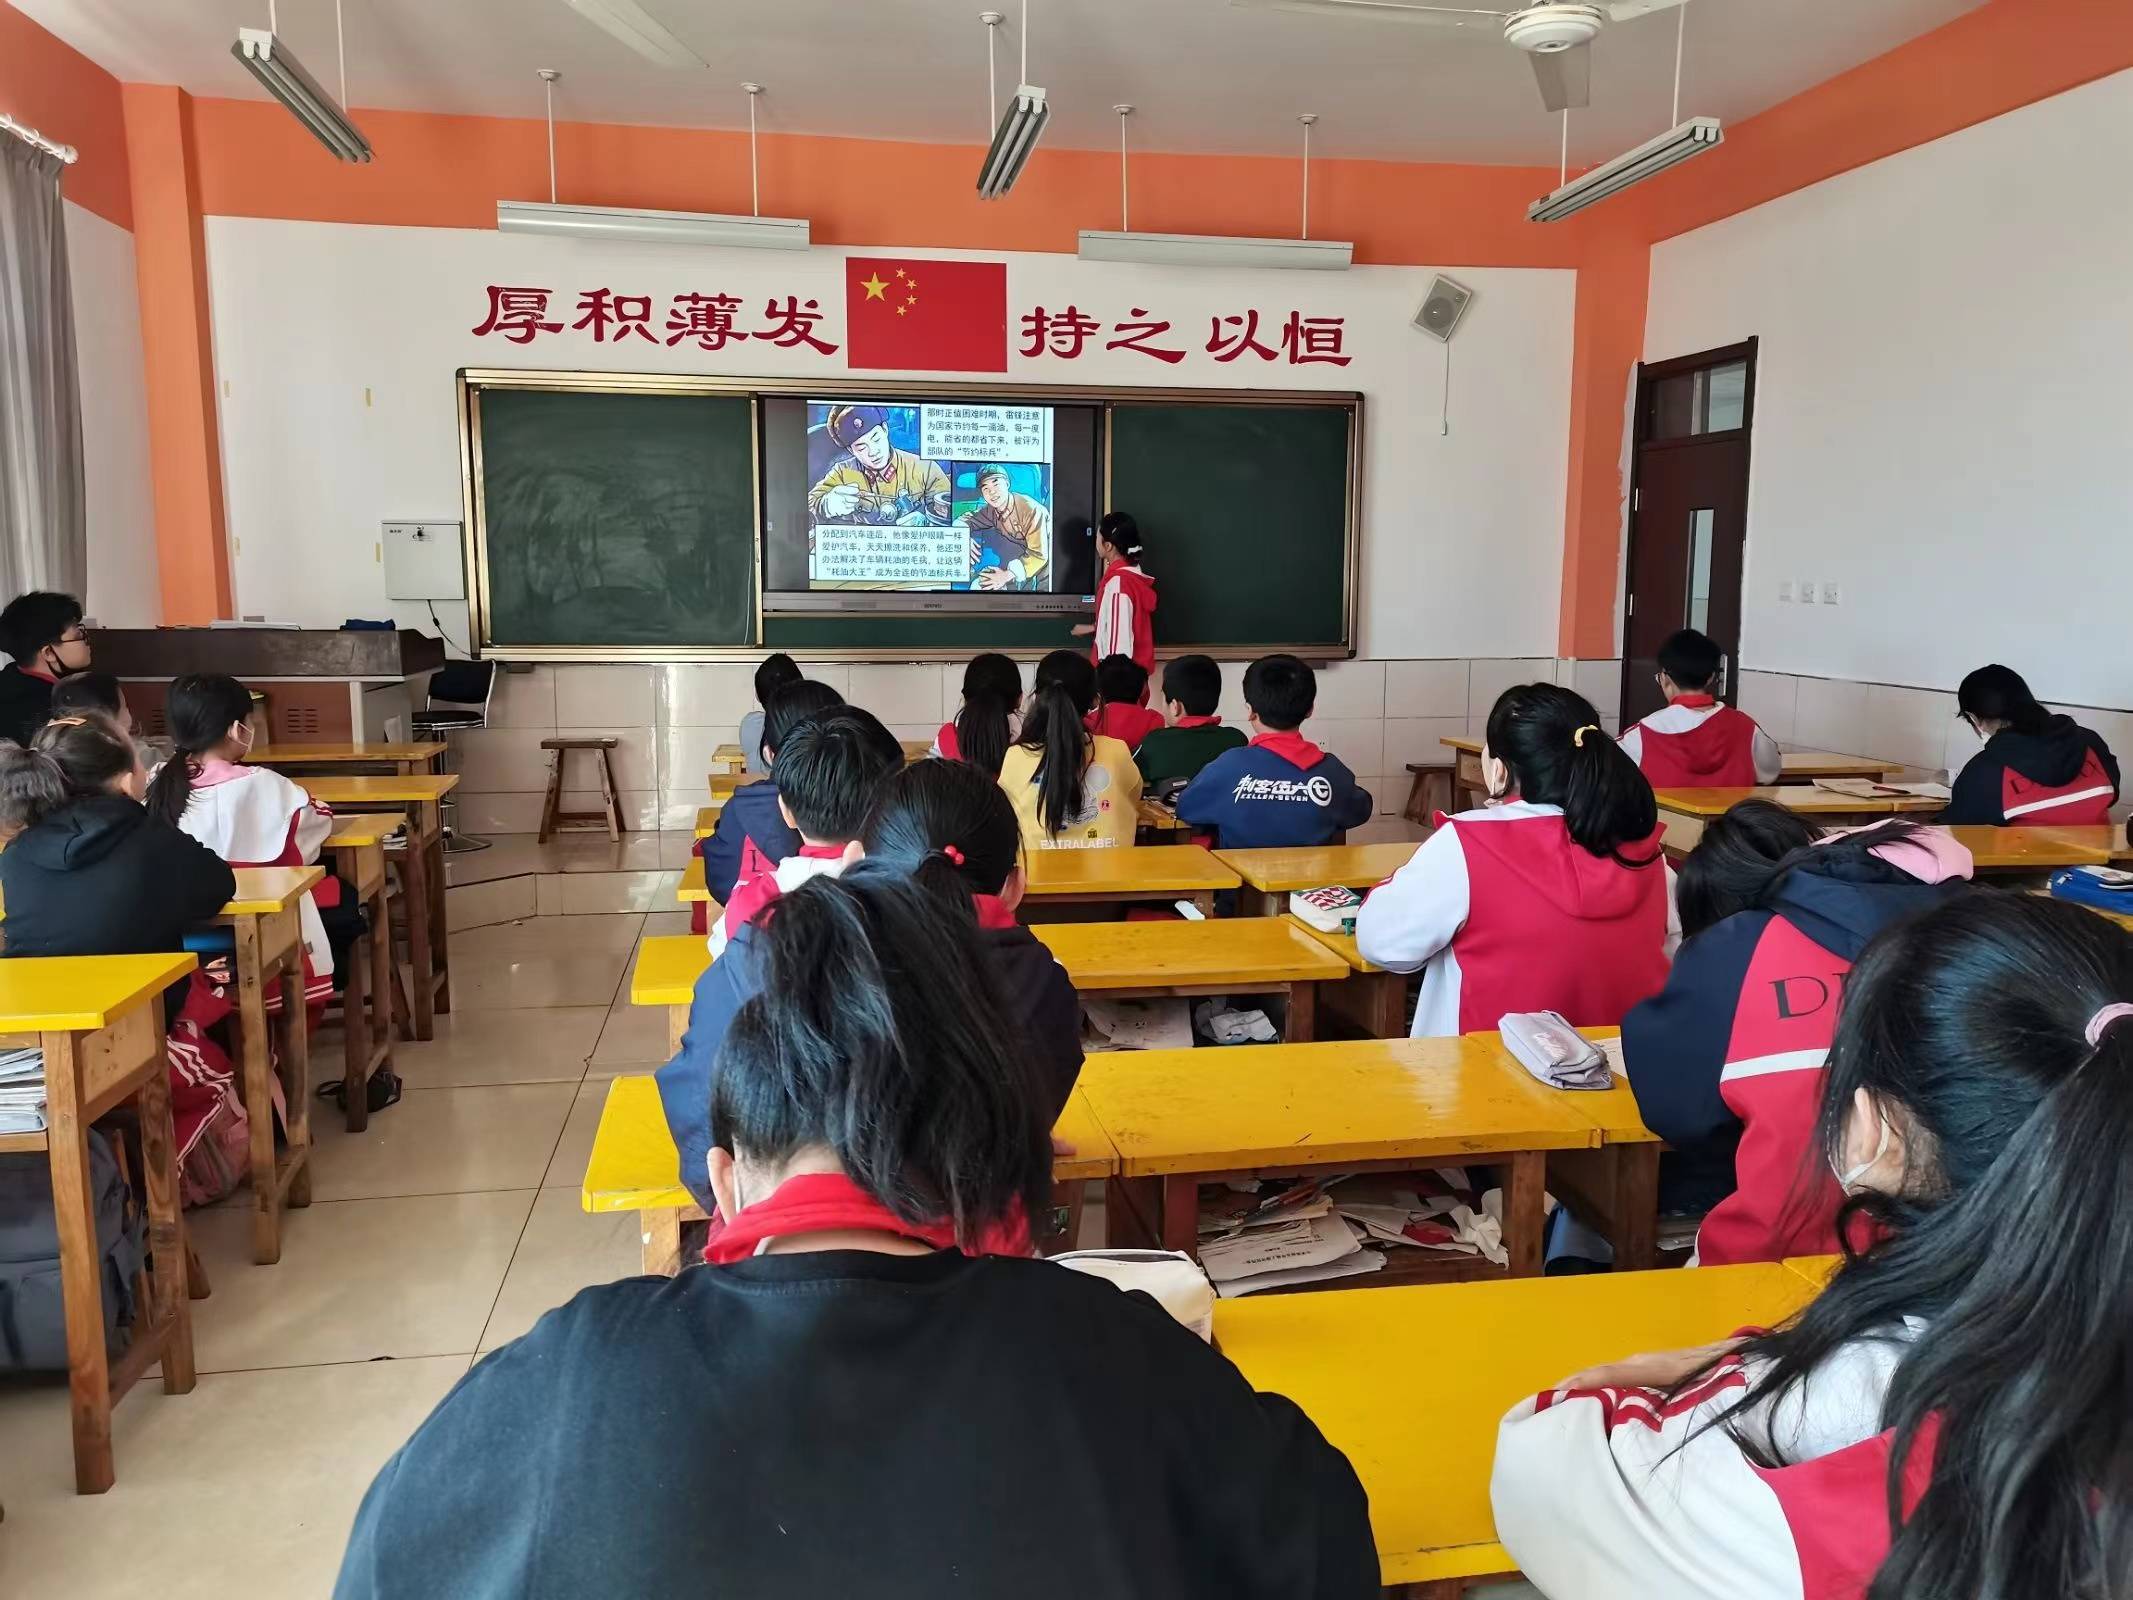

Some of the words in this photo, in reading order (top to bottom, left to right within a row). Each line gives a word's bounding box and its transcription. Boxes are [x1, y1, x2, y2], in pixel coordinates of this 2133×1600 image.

[471, 285, 840, 356] 厚积薄发
[1018, 305, 1353, 367] 持之以恒
[1040, 837, 1120, 850] EXTRALABEL
[1768, 973, 1848, 1019] D
